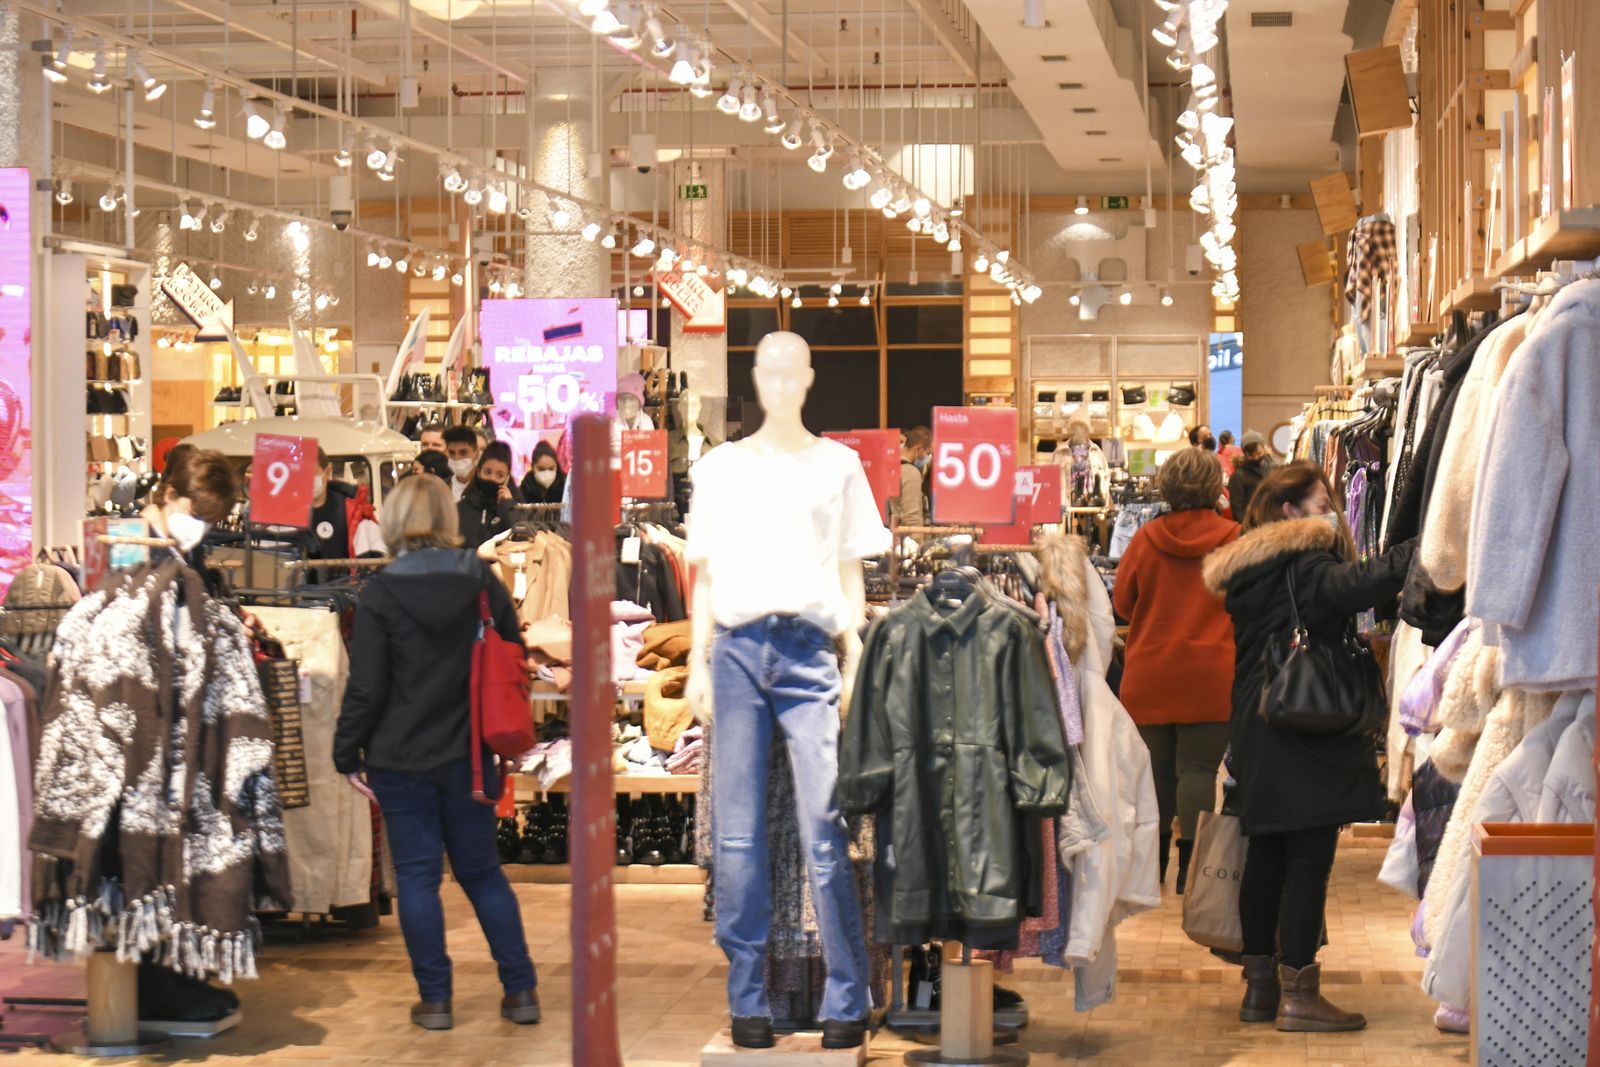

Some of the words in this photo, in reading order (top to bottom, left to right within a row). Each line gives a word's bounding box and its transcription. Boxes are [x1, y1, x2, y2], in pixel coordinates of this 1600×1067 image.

[495, 345, 604, 363] REBAJAS
[939, 412, 969, 424] Hasta
[624, 449, 653, 476] 15
[266, 461, 290, 496] 9
[1020, 478, 1030, 488] A
